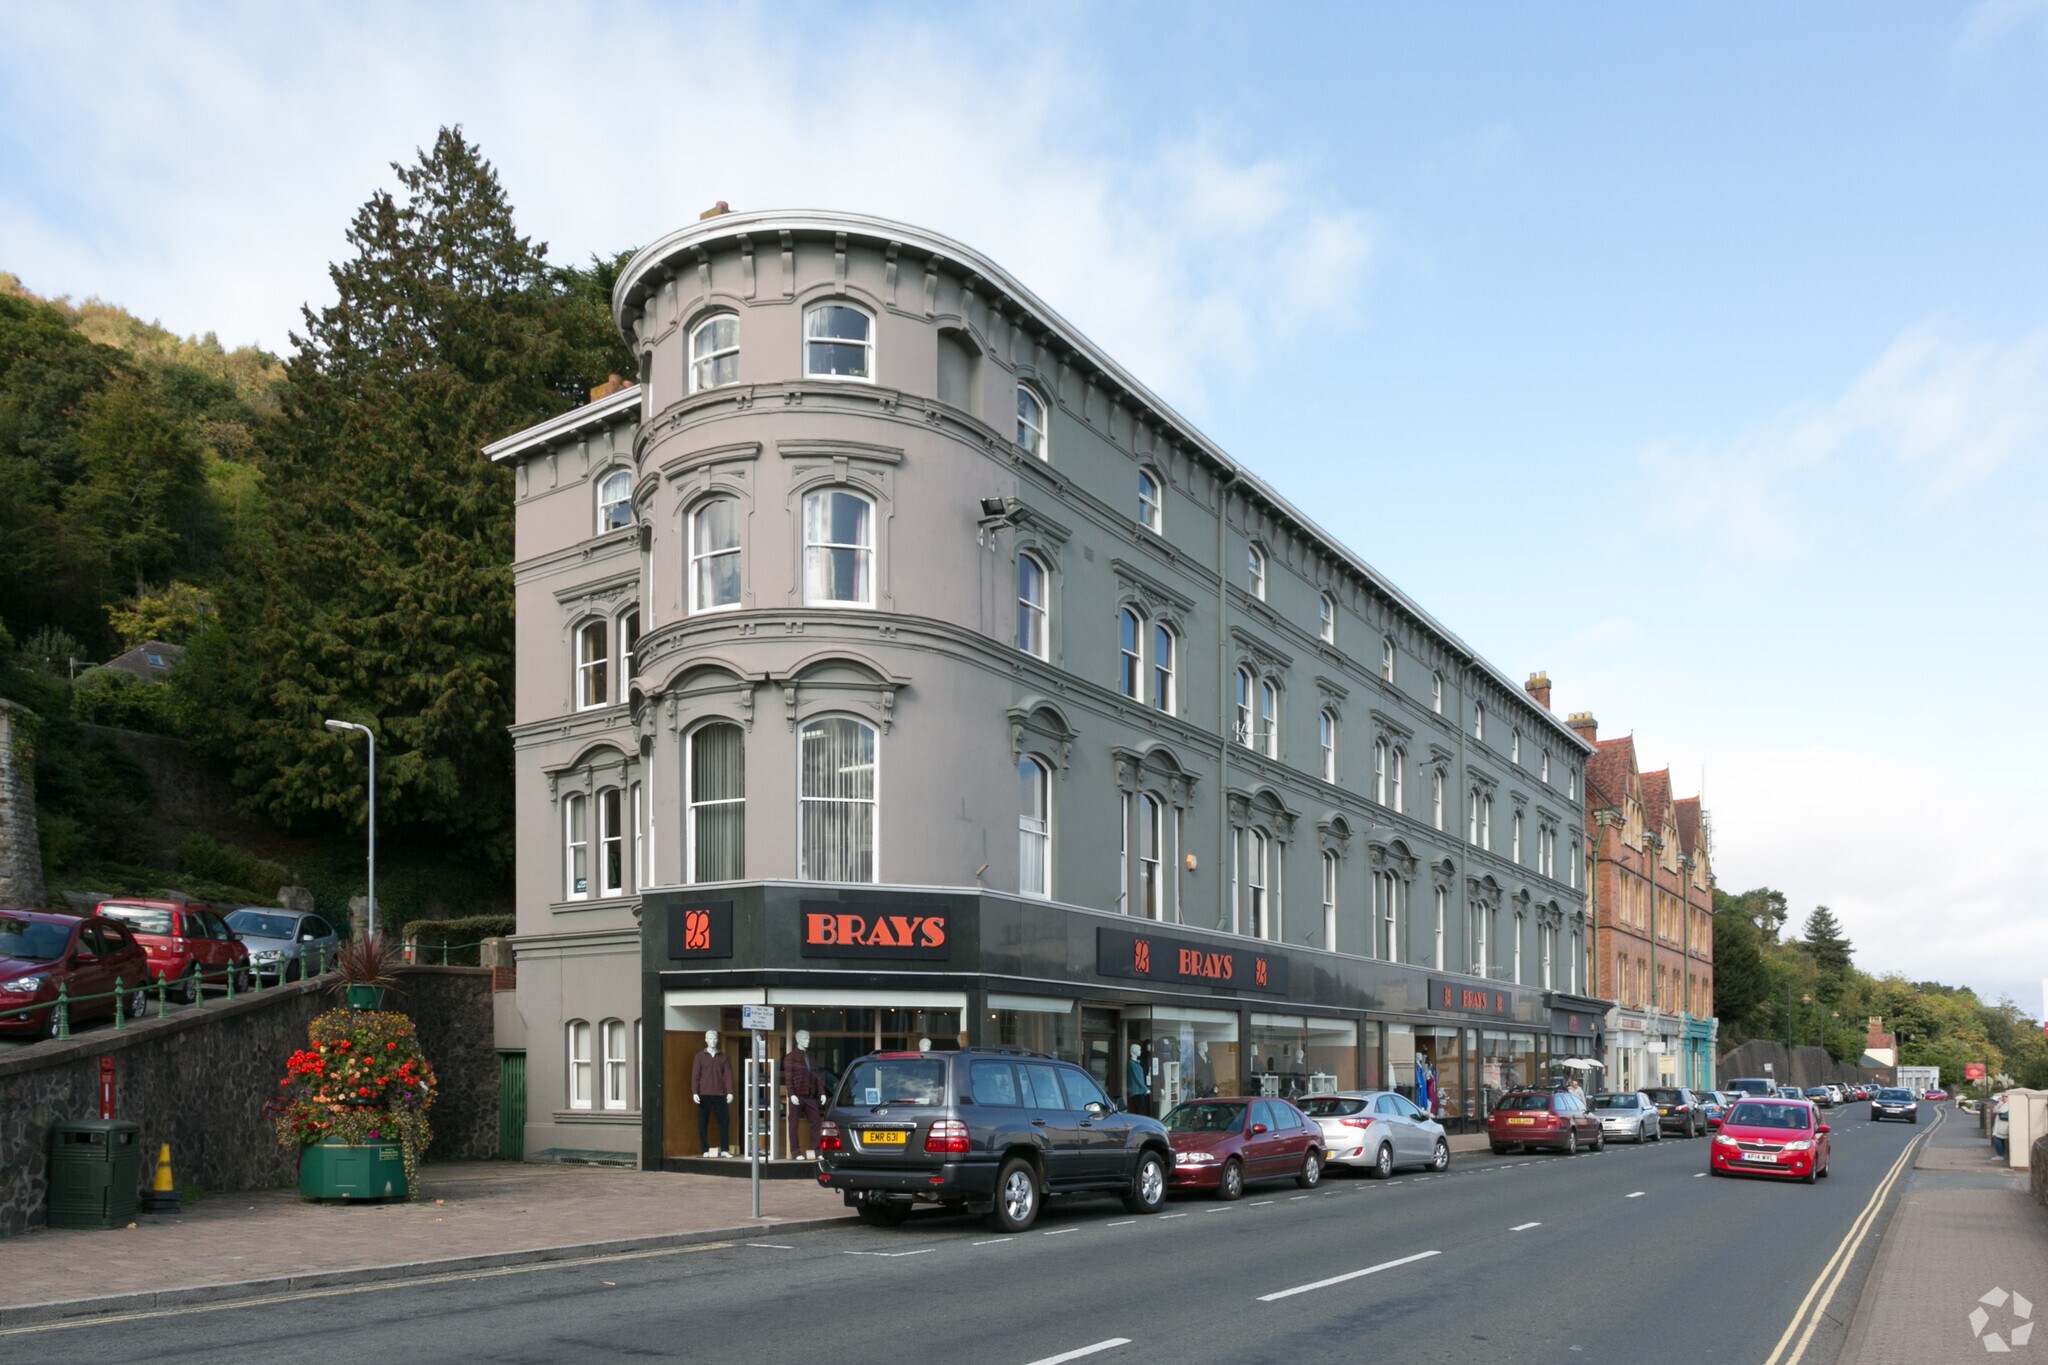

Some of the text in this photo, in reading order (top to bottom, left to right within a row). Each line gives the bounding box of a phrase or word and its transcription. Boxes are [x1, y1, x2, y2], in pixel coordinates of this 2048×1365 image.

[806, 912, 945, 948] BRAYS
[1178, 948, 1232, 980] BRAYS
[870, 1132, 884, 1141] EMR
